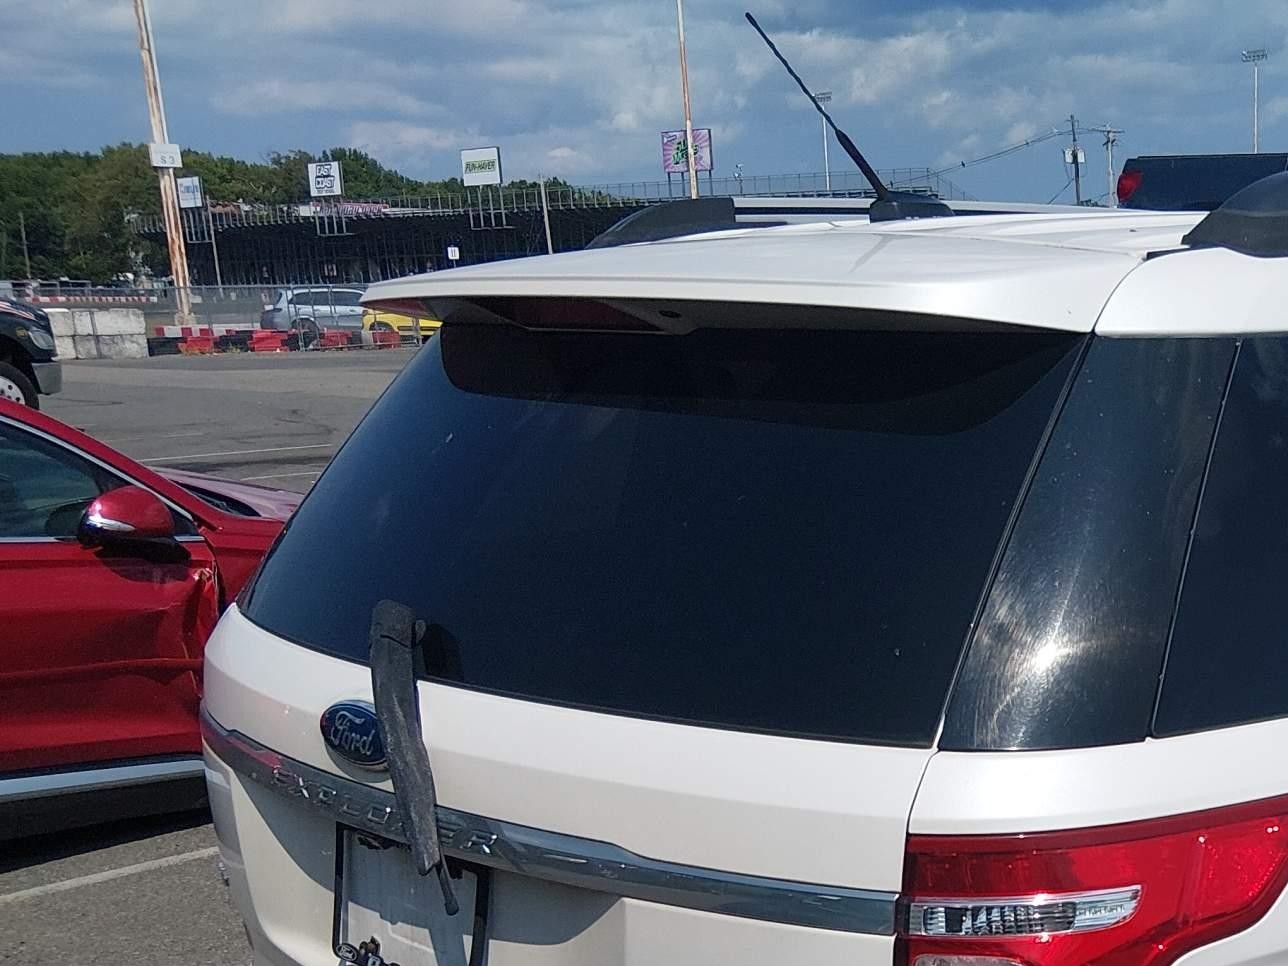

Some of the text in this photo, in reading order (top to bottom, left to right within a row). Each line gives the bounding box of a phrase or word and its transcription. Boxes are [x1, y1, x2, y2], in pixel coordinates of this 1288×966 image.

[315, 164, 332, 176] EAST
[315, 176, 335, 189] COAST
[331, 710, 376, 756] Ford
[271, 765, 498, 855] EXPLOER
